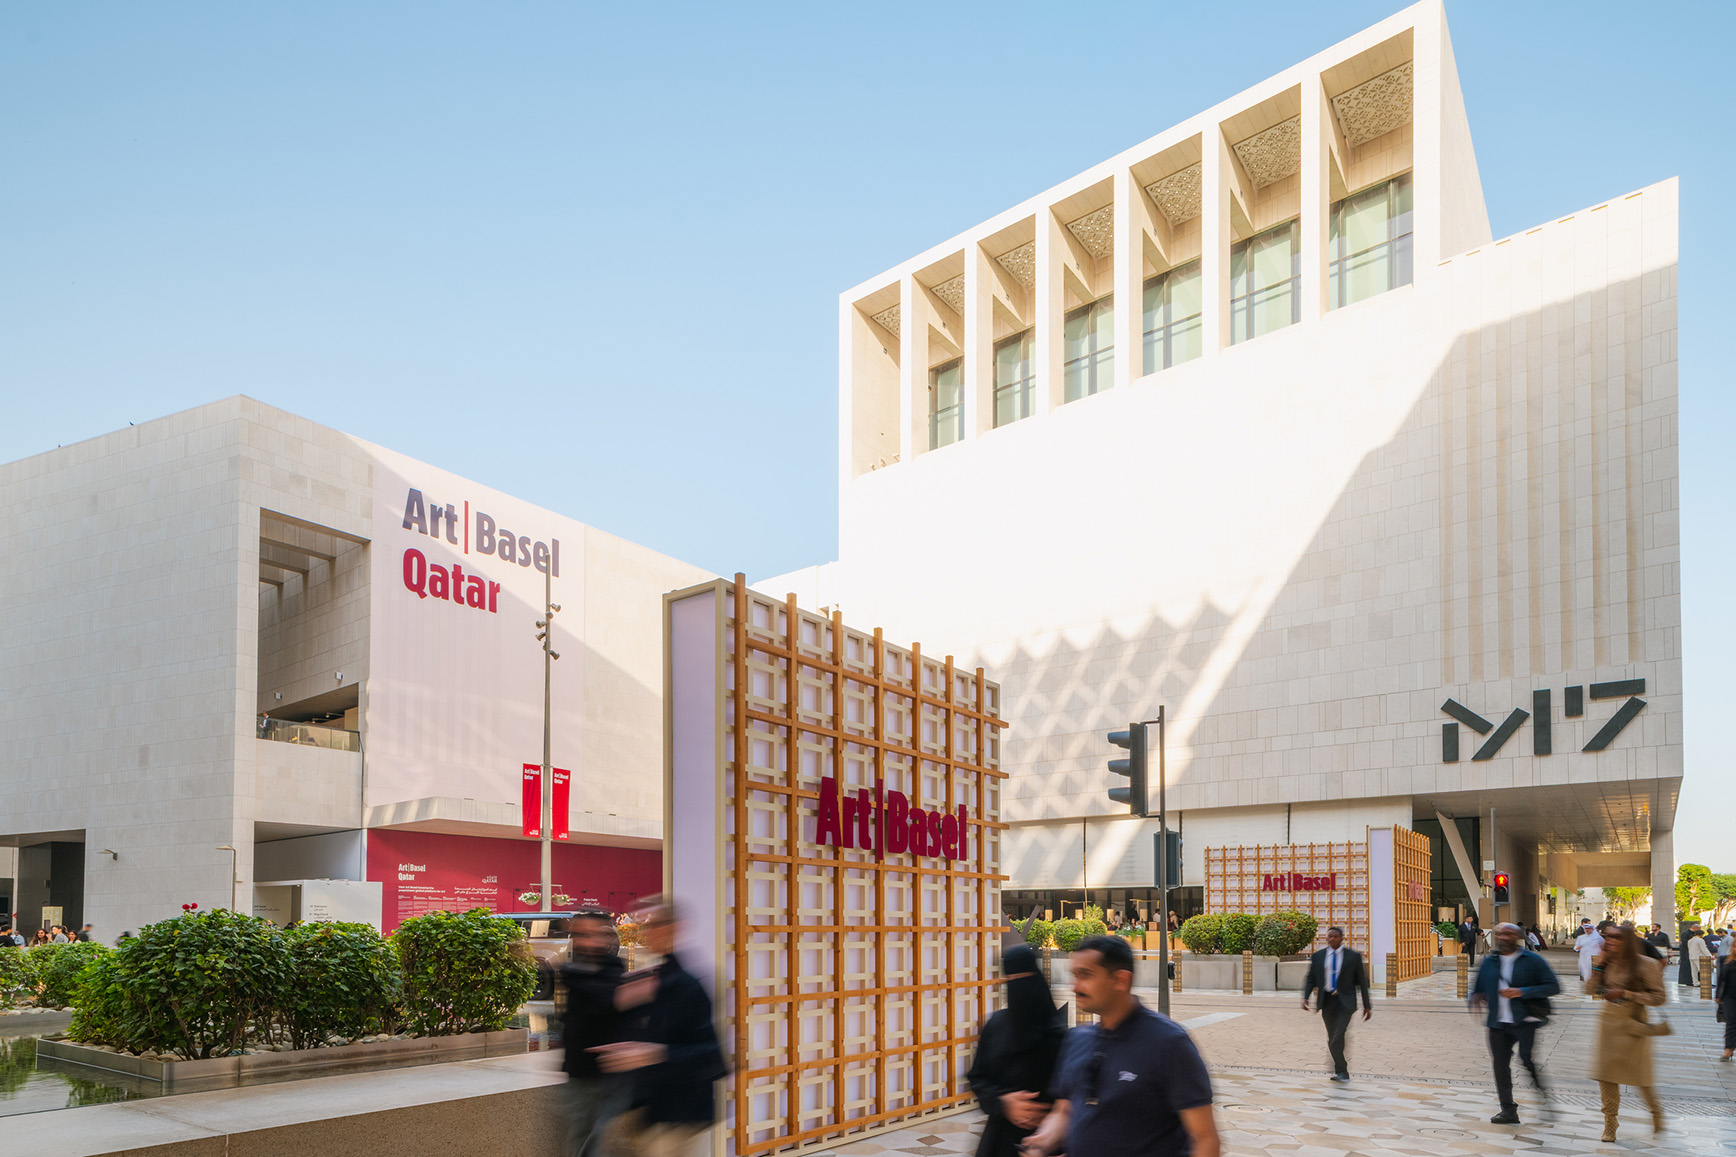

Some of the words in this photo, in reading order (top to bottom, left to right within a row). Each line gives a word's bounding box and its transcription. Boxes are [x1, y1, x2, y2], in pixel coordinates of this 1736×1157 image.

[402, 488, 458, 545] Art
[476, 511, 559, 578] Basel
[403, 548, 500, 613] Qatar
[816, 776, 872, 850] Art
[887, 790, 967, 861] Basel
[398, 873, 415, 881] Qatar
[1263, 873, 1285, 891] Art
[1293, 873, 1337, 891] Basel
